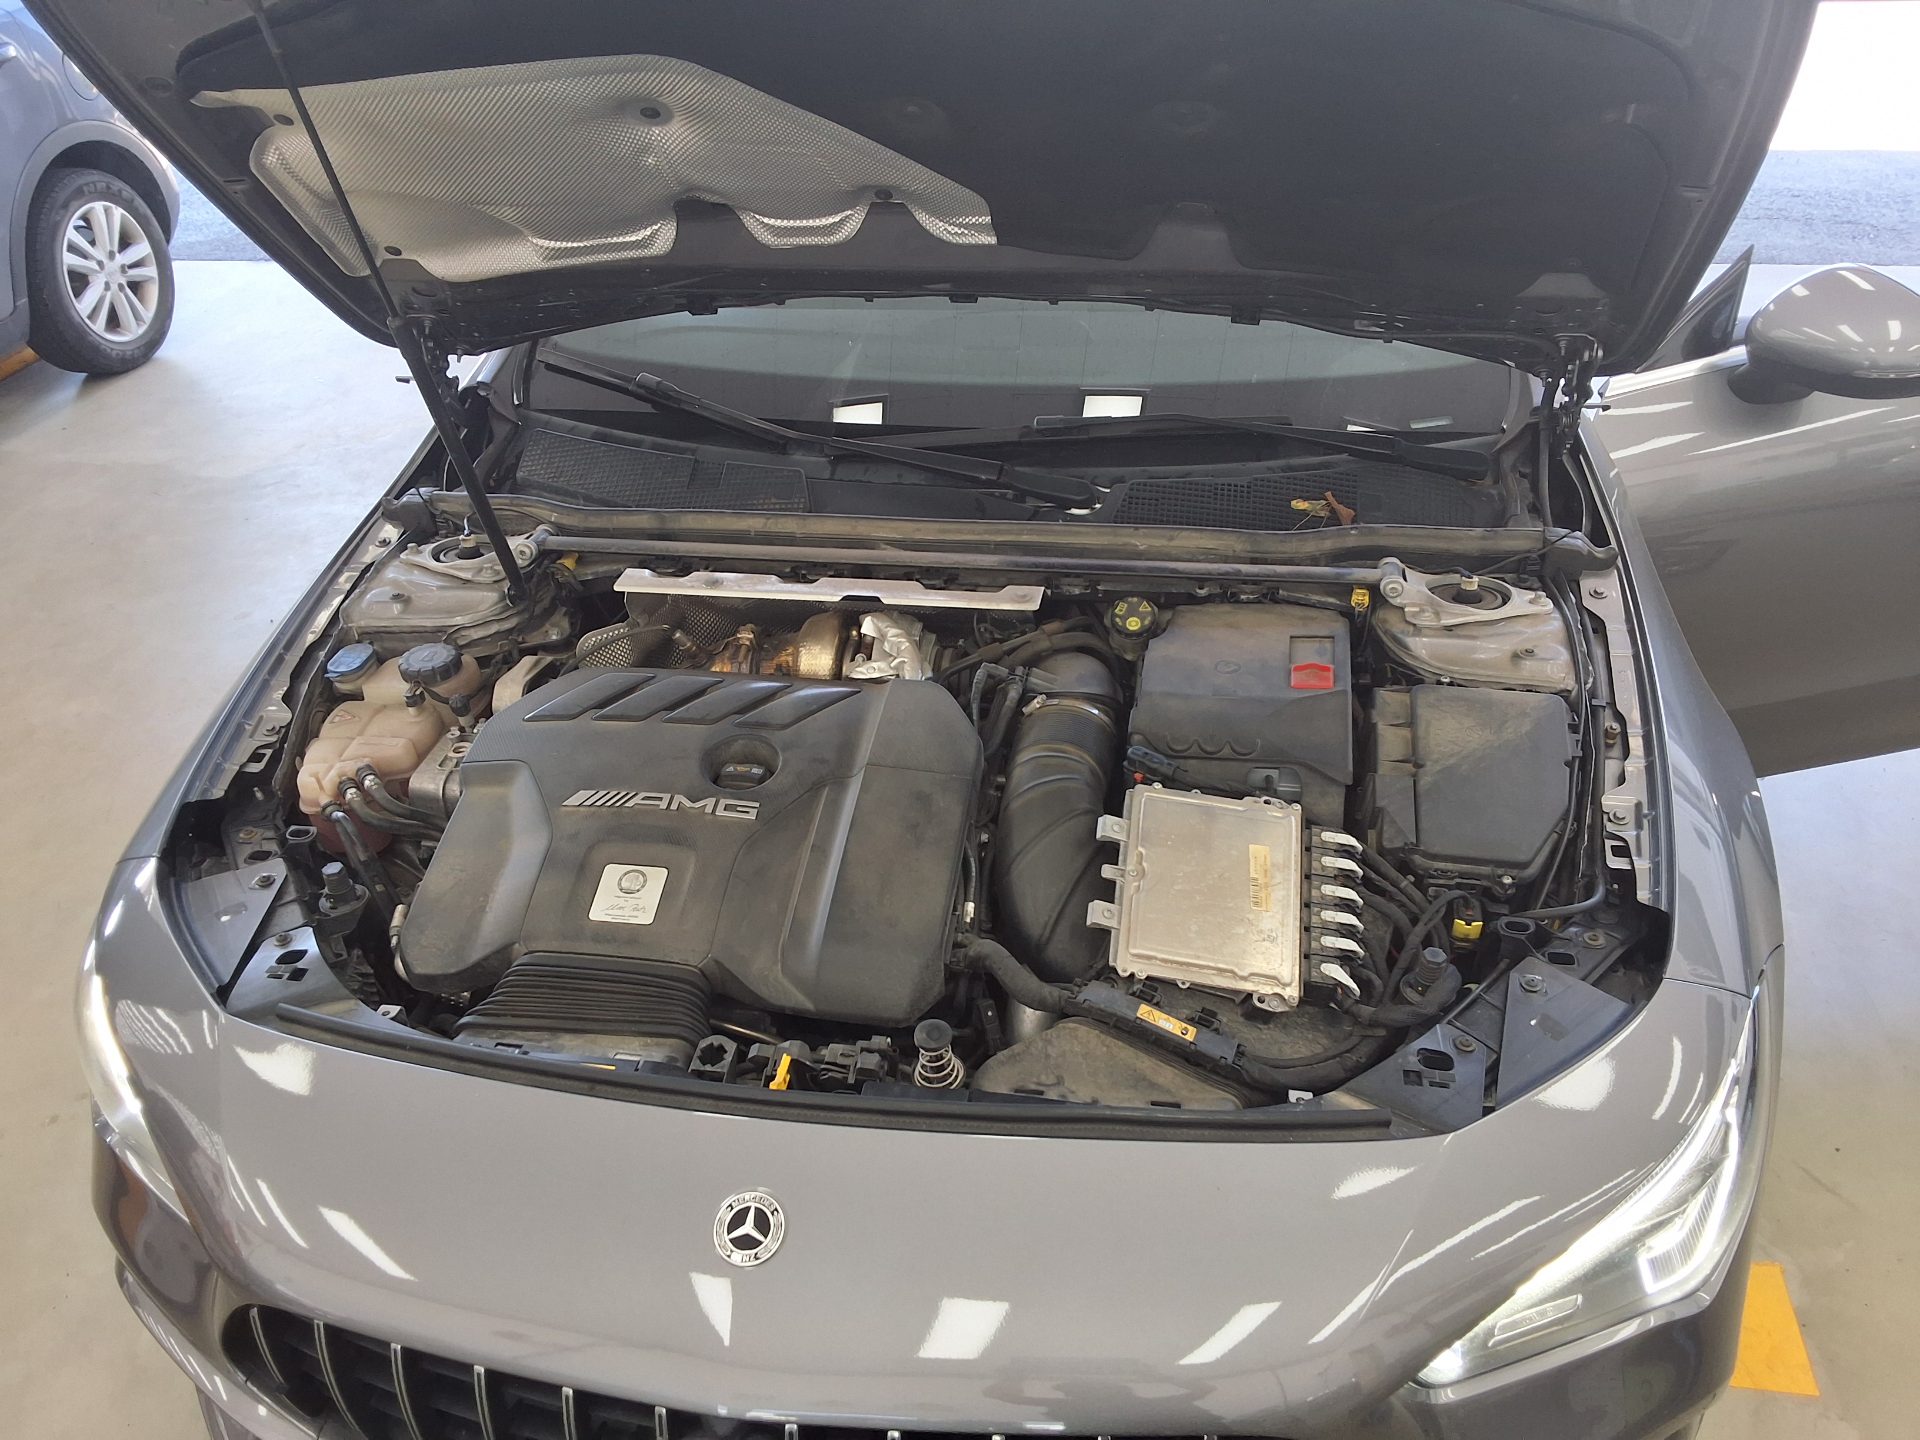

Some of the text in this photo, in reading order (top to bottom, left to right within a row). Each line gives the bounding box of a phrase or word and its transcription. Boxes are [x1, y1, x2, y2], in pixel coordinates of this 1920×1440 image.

[626, 791, 760, 820] AMG
[731, 1194, 776, 1211] MERCEDES
[730, 1253, 756, 1265] NZ
